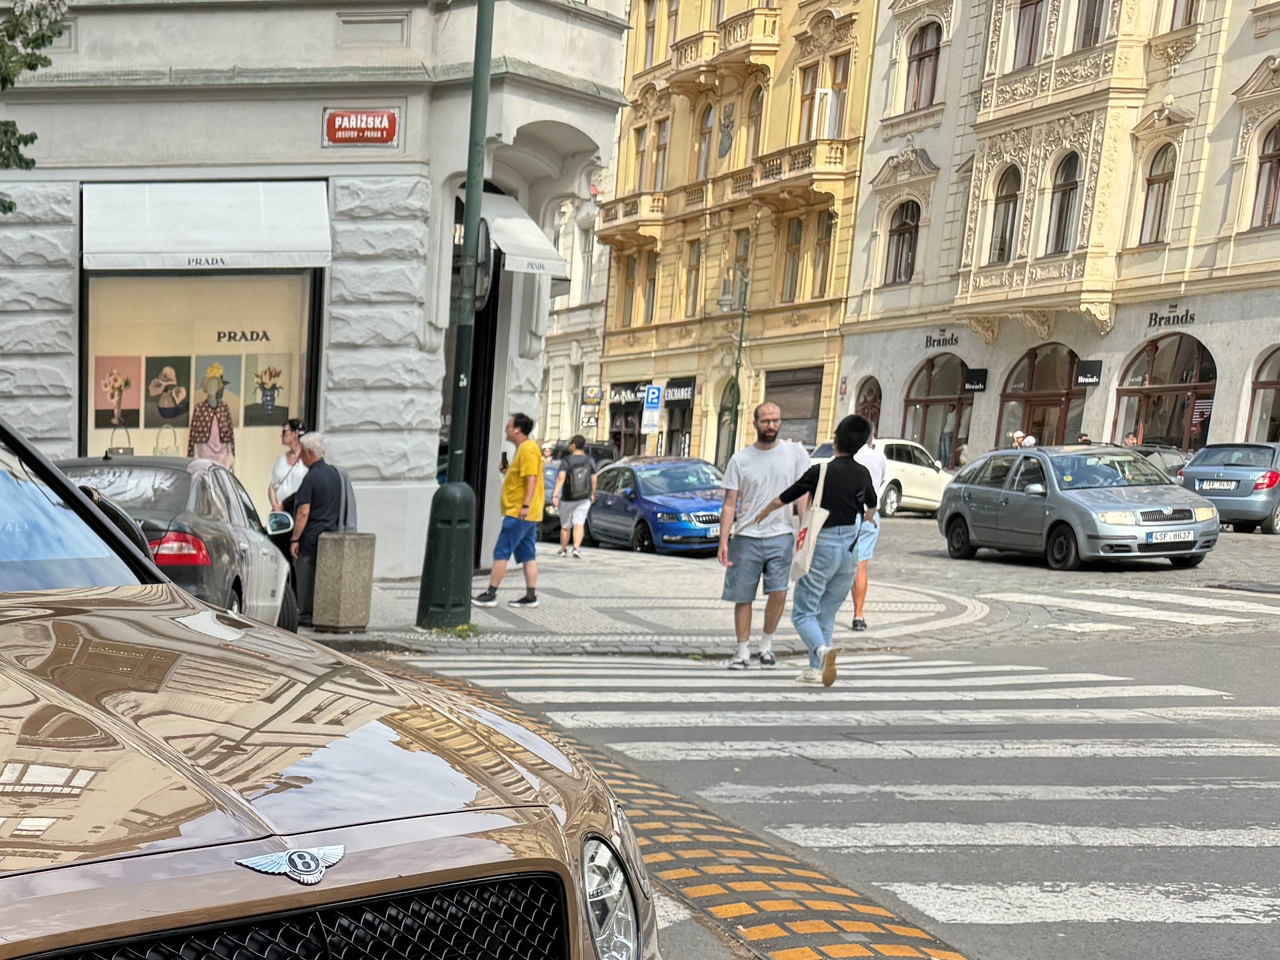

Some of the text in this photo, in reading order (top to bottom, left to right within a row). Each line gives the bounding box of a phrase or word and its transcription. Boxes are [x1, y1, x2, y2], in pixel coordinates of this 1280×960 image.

[335, 114, 389, 129] PAŘÍŽSKÁ
[187, 257, 226, 266] PRADA
[1147, 309, 1196, 328] Brands
[216, 330, 271, 342] PRADA
[925, 332, 959, 348] Brands
[291, 852, 317, 872] B
